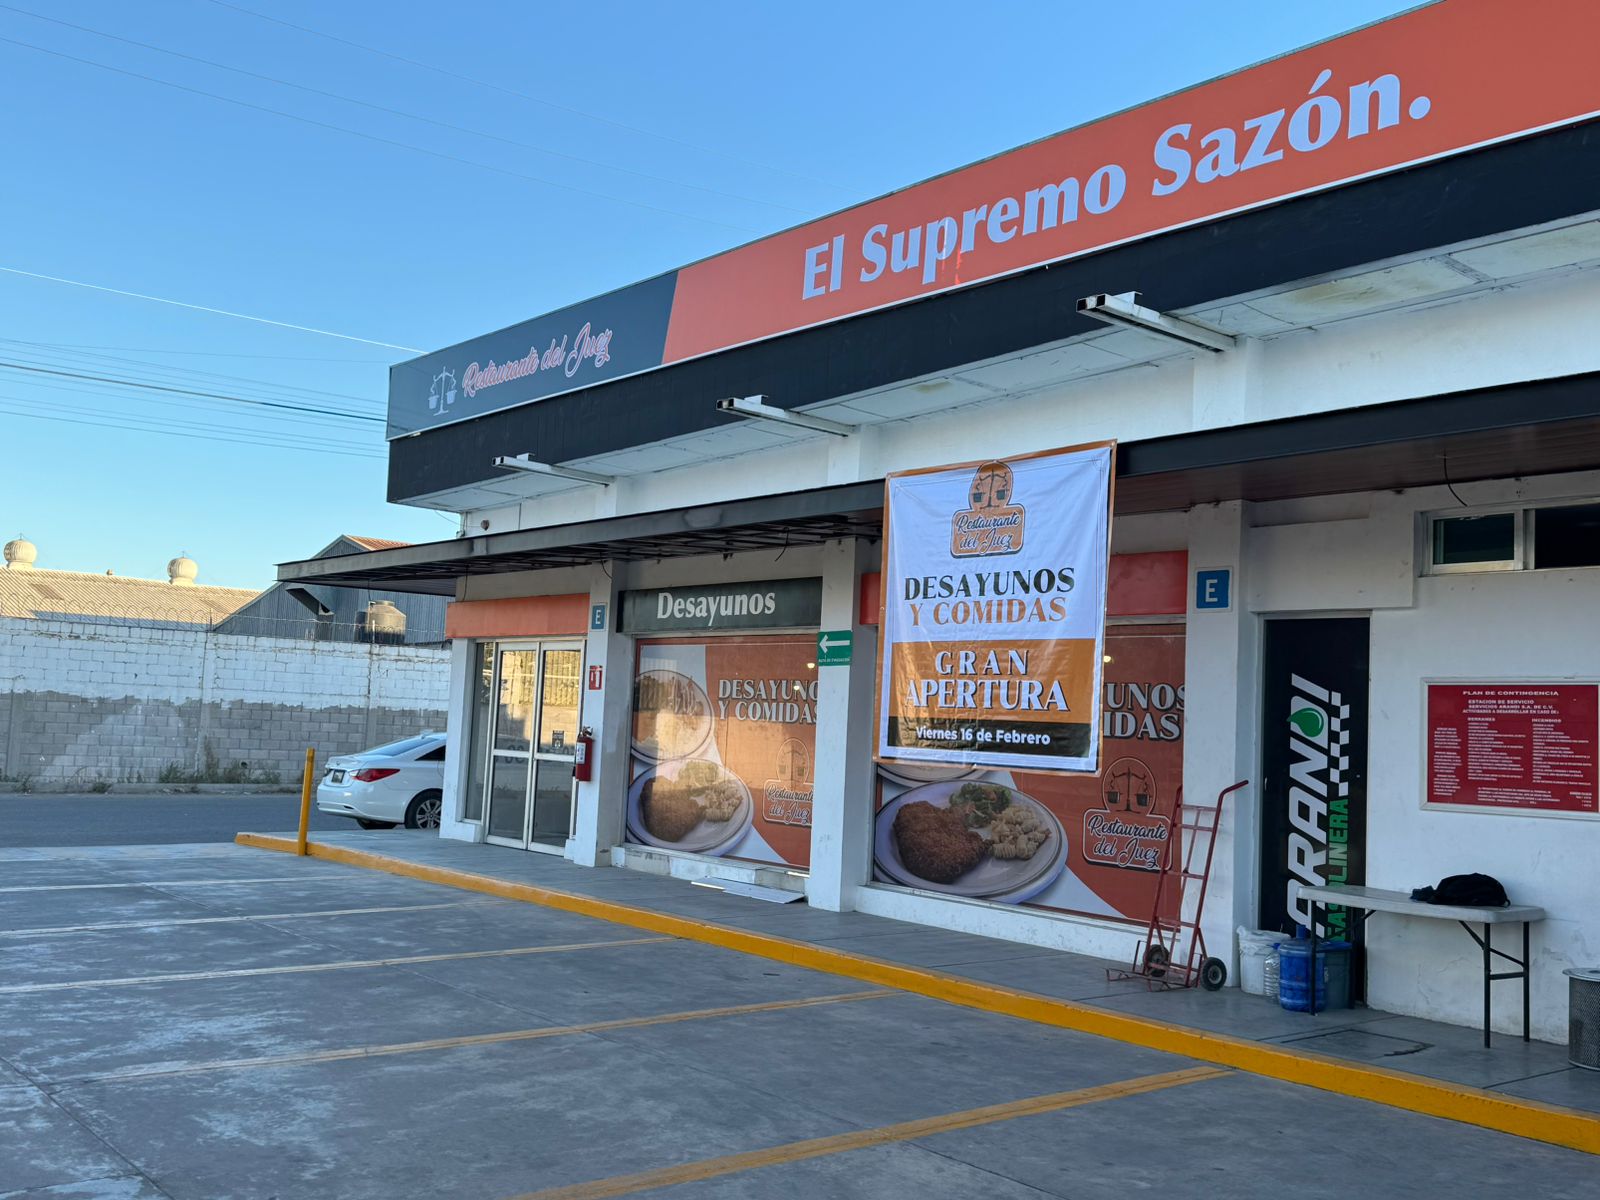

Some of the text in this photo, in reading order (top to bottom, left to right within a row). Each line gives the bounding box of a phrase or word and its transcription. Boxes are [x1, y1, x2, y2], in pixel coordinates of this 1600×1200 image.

[802, 69, 1431, 300] El Supremo Sazón.
[462, 321, 613, 398] Restaurante del Juez
[955, 510, 1021, 534] Restaurante
[959, 527, 1014, 555] del Juez
[904, 567, 1075, 601] DESAYUNOS
[1205, 579, 1218, 602] E
[595, 609, 601, 625] E
[657, 592, 776, 626] Desayunos
[910, 596, 1067, 626] Y COMIDAS
[935, 649, 1030, 676] GRAN
[906, 678, 1071, 712] APERTURA
[718, 701, 817, 724] Y COMIDA
[916, 726, 1051, 745] Viernes 16 de Febrero
[766, 783, 814, 802] Restaurant
[1087, 815, 1168, 841] Restaurante
[1093, 837, 1159, 868] del Juez
